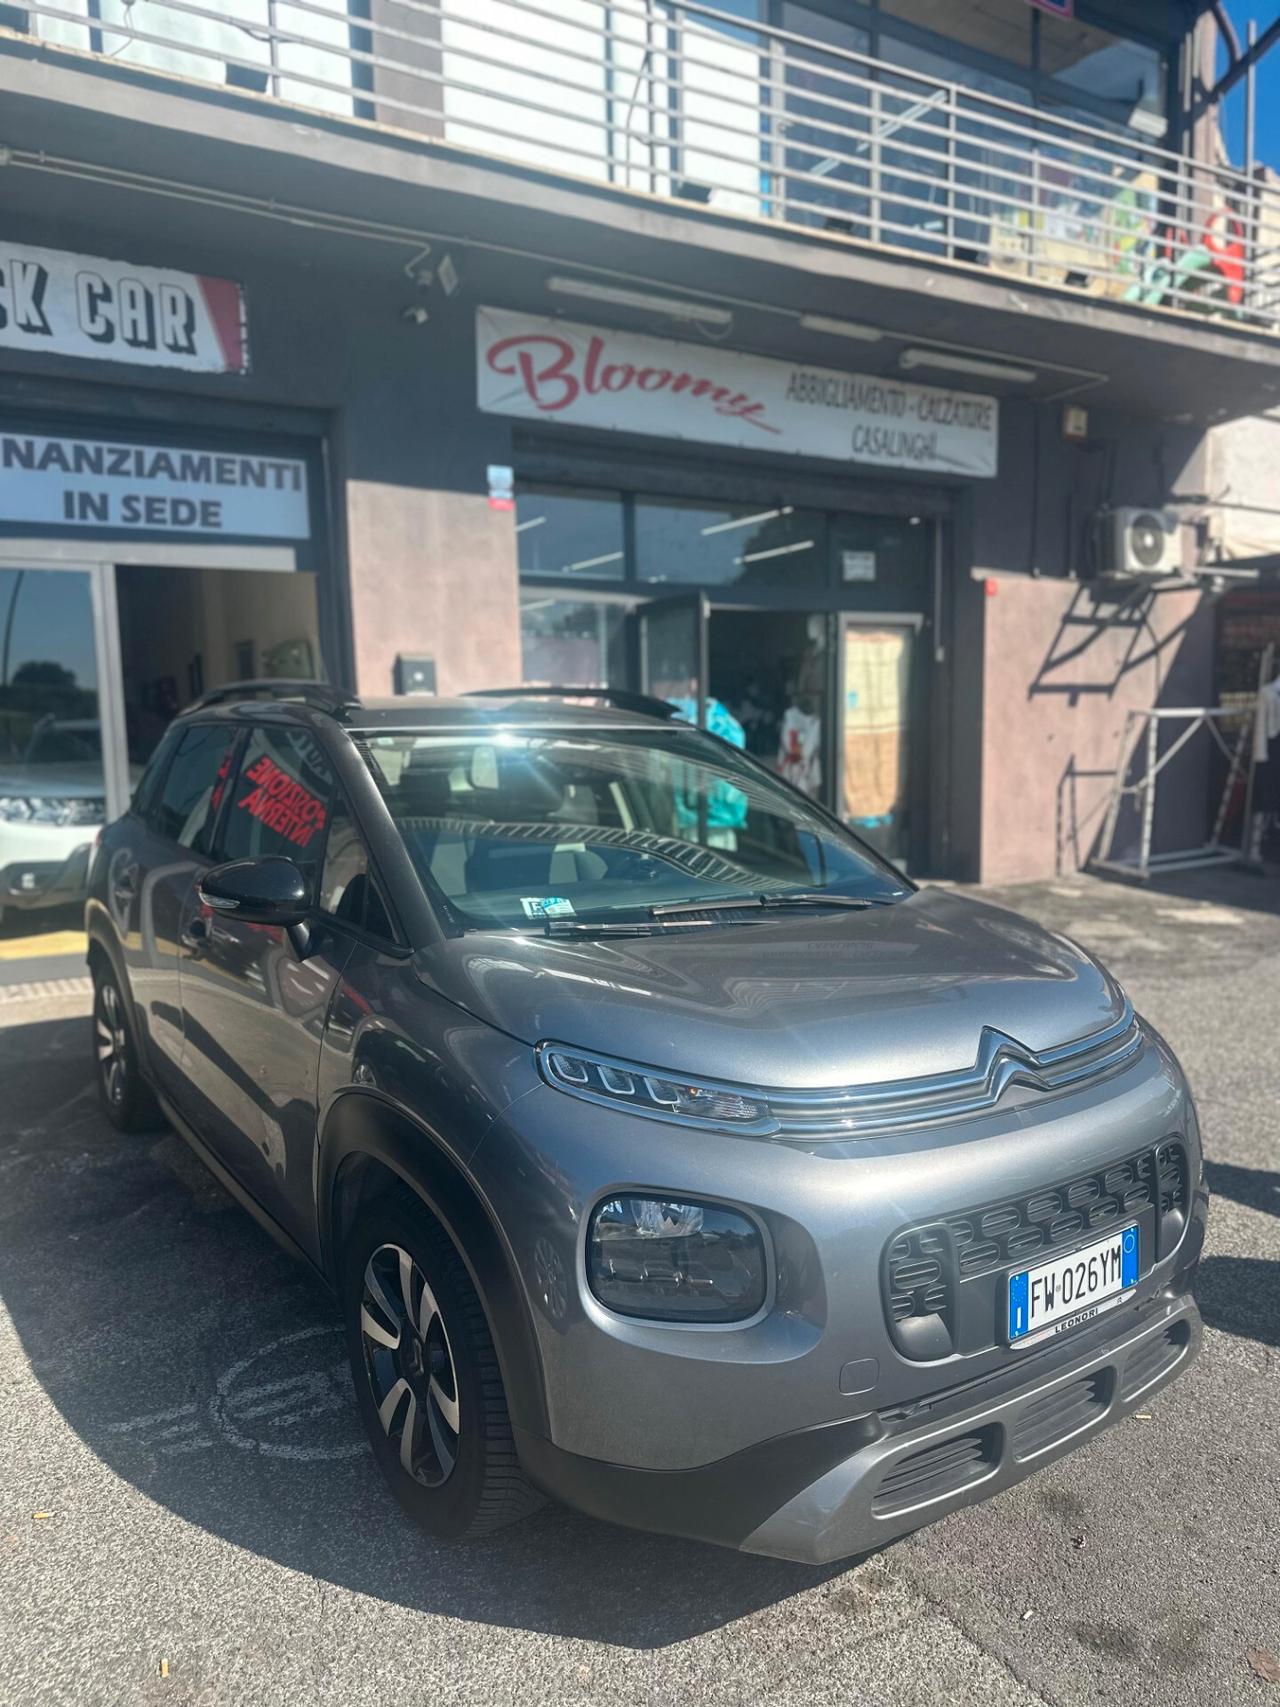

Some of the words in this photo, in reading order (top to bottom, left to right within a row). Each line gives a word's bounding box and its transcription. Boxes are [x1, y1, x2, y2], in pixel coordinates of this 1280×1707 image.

[75, 270, 197, 356] CAR
[486, 333, 782, 435] Bloomy
[786, 371, 907, 418] ABBIGLIAMENTO
[916, 393, 993, 431] CALZATURE
[2, 438, 303, 492] NANZIAMENTI
[63, 491, 109, 522] IN
[121, 495, 222, 528] SEDE
[1055, 1308, 1099, 1333] LEONORI
